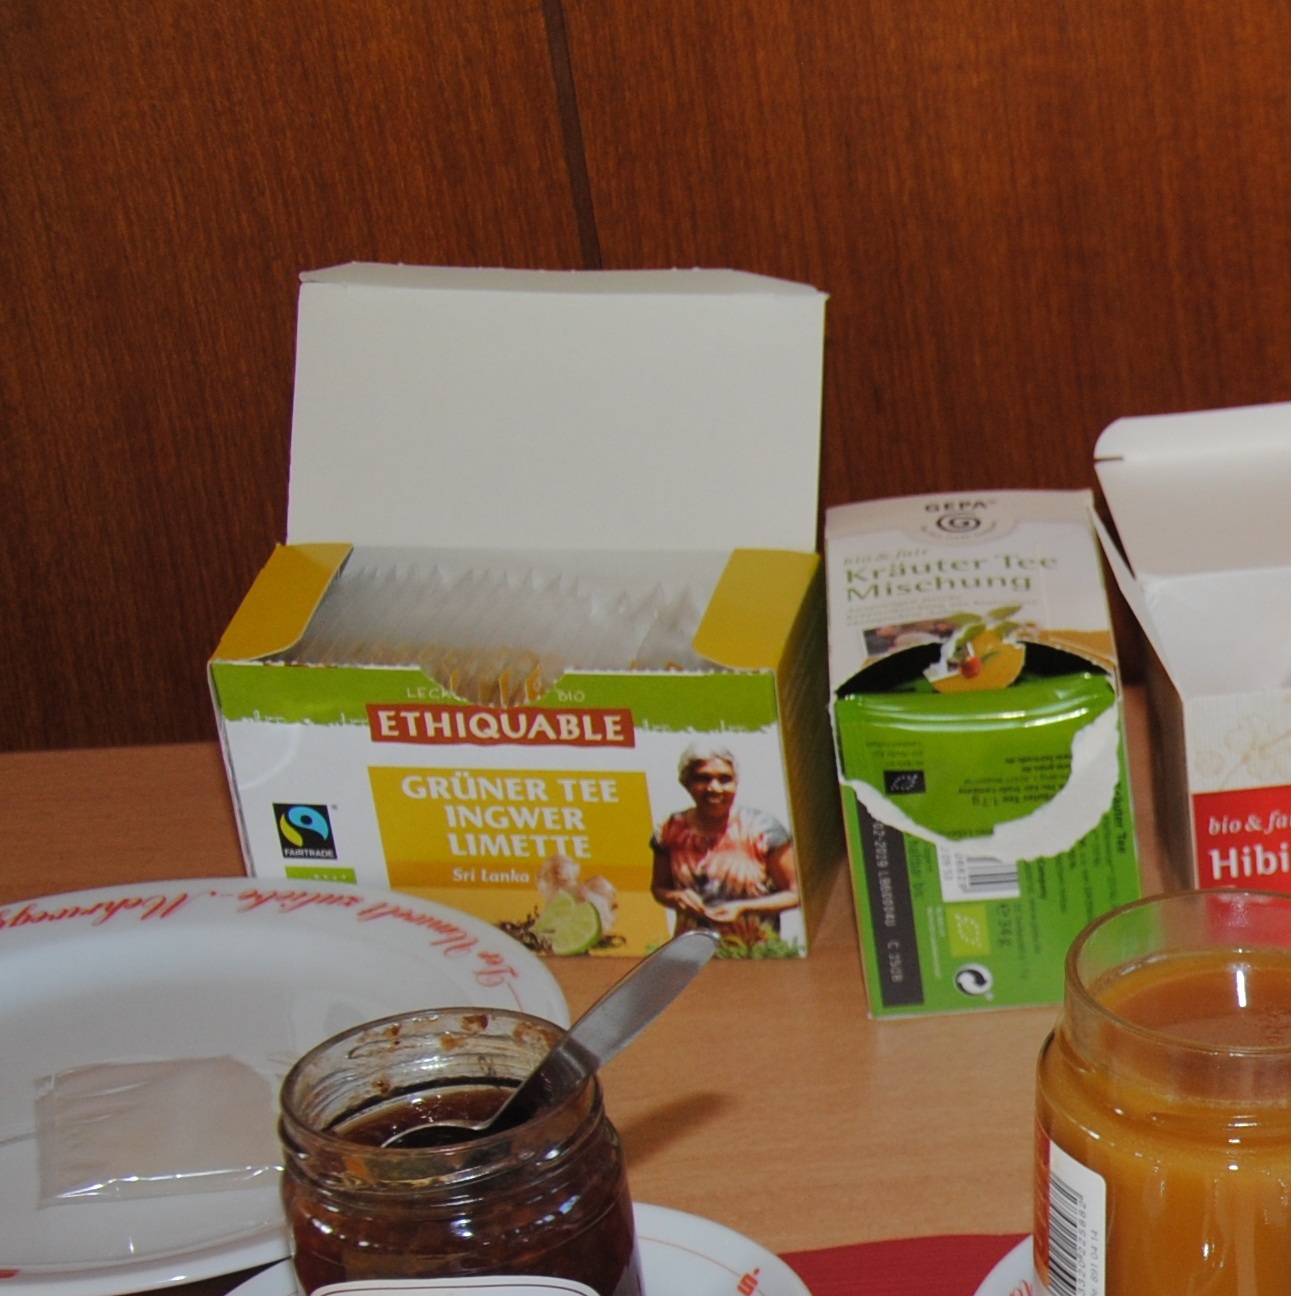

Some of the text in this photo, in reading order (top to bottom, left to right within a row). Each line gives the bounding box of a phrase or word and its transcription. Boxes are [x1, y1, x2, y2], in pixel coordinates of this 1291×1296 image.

[925, 500, 988, 512] GEPA
[845, 554, 1059, 584] Kräuter Tee
[846, 575, 1032, 603] Mischung
[558, 691, 586, 703] BIO
[378, 709, 626, 743] ETHIQUABLE
[401, 770, 619, 803] GRÜNER TEE
[444, 804, 587, 831] INGWER
[1208, 815, 1245, 836] bio
[1245, 812, 1263, 832] &
[283, 847, 338, 860] FAIRTRADE
[448, 832, 592, 860] LIMETTE
[452, 867, 531, 885] Sri Lanka
[1089, 1246, 1098, 1261] 04
[1089, 1263, 1098, 1284] 891
